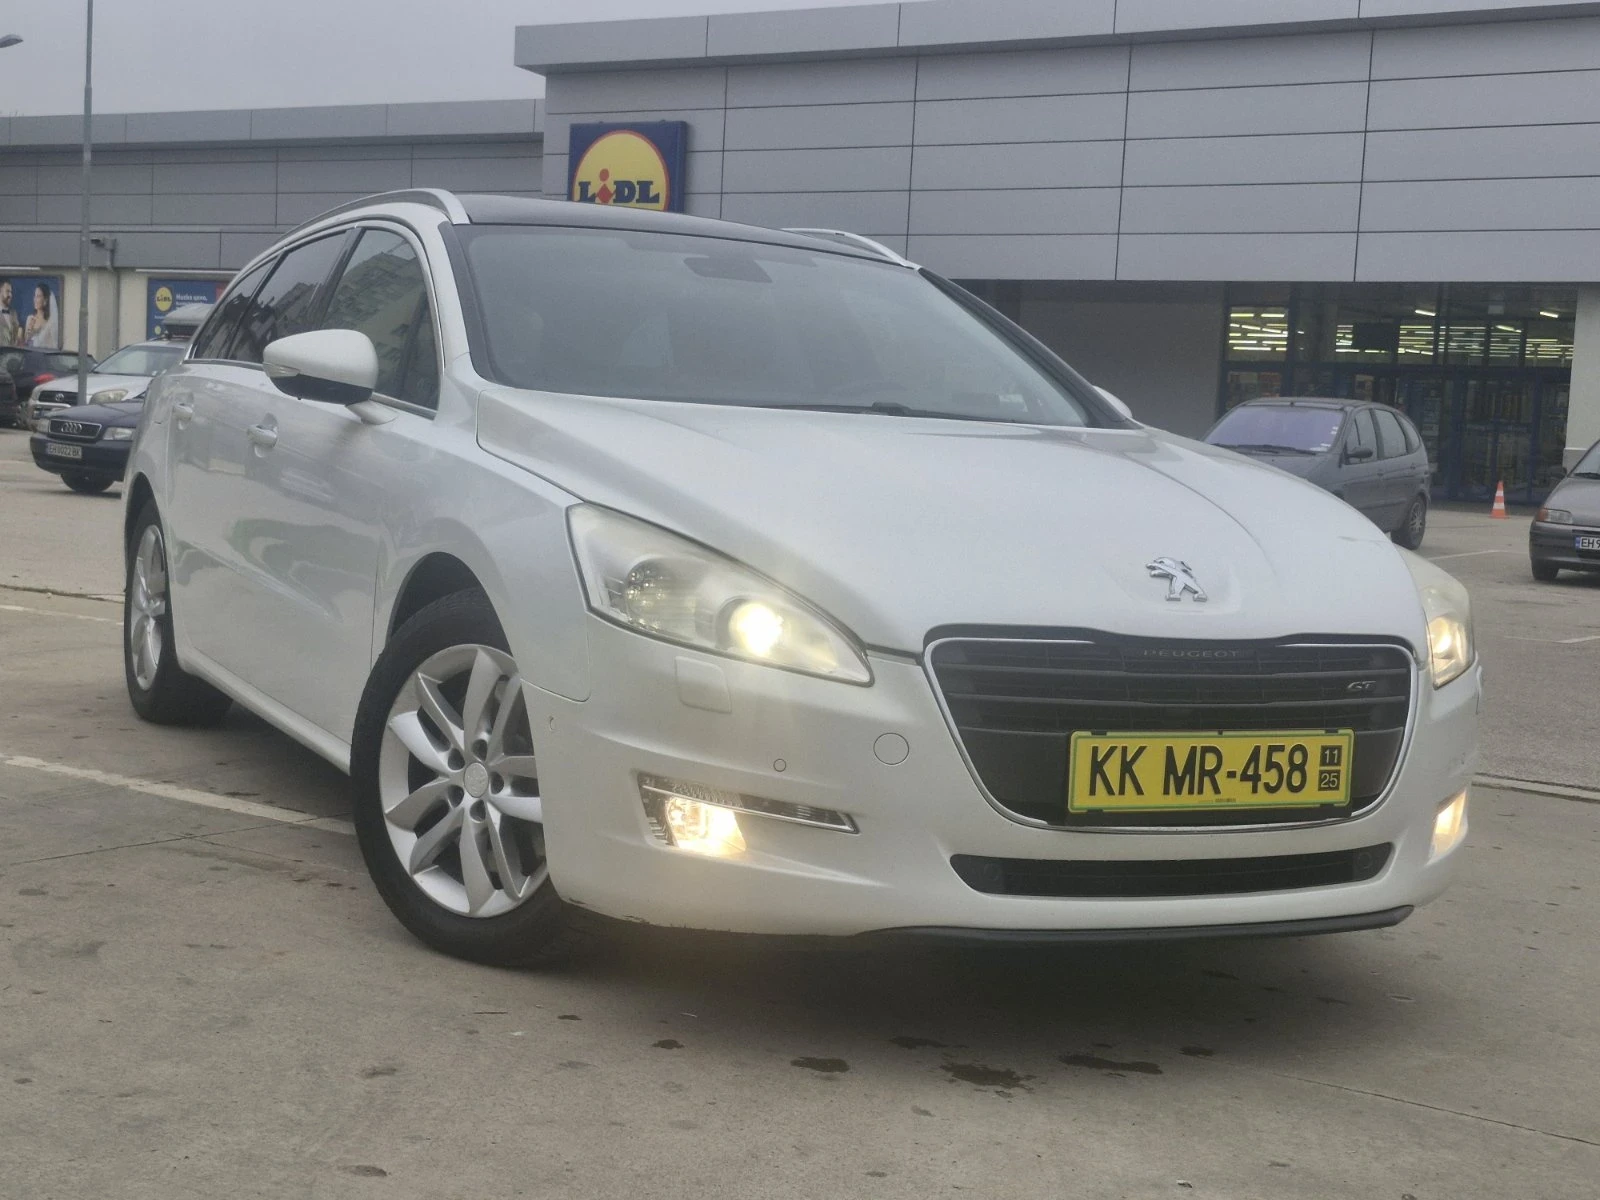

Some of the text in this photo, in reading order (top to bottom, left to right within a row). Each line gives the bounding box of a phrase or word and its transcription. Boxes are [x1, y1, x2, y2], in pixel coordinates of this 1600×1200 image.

[1581, 538, 1595, 549] EH
[1143, 649, 1240, 658] PEUGEOT
[1347, 680, 1377, 690] GT
[1324, 748, 1339, 764] 11
[1088, 743, 1309, 796] KK MR-458
[1320, 772, 1339, 788] 25
